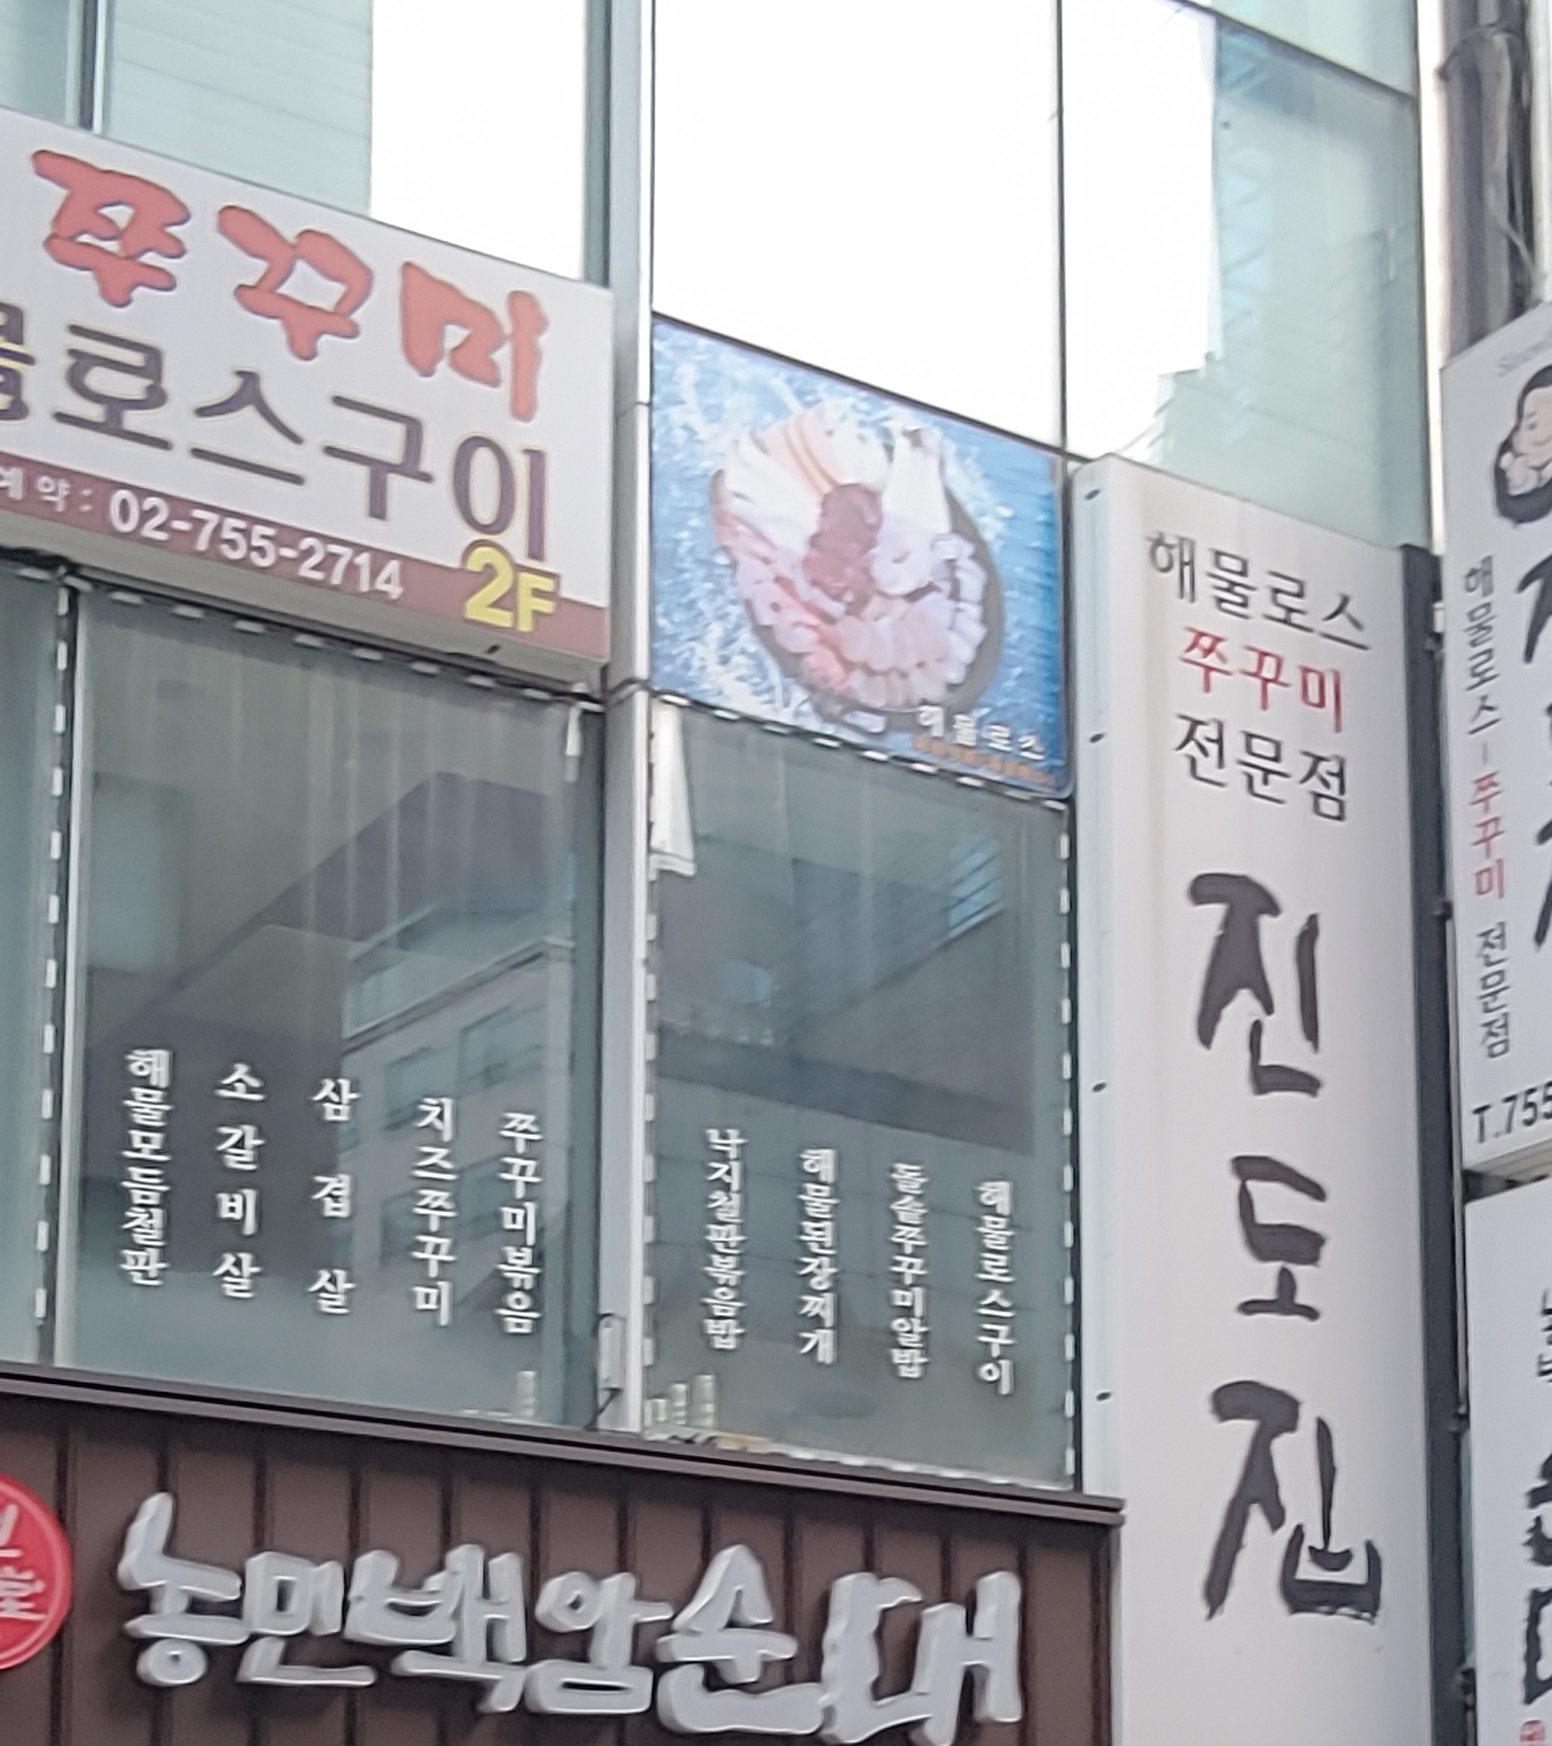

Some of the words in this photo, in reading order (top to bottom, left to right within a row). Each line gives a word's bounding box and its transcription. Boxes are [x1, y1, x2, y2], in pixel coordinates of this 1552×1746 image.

[108, 487, 405, 600] 02-755-2714
[462, 541, 560, 632] 2F
[1146, 530, 1372, 652] 해물로스
[1175, 712, 1352, 823] 전문점
[1476, 921, 1511, 1060] 전문점
[120, 1048, 174, 1287] 해물모듬철판
[212, 1062, 267, 1300] 소갈비살
[306, 1077, 361, 1316] 삼겹살
[411, 1096, 460, 1328] 치즈쭈꾸미
[495, 1111, 545, 1336] 쭈꾸미볶음
[701, 1127, 748, 1352] 낙지철판볶음밥
[797, 1147, 840, 1365] 해물된장찌개
[1186, 872, 1384, 1622] 진도집
[974, 1180, 1018, 1396] 해물로스구이
